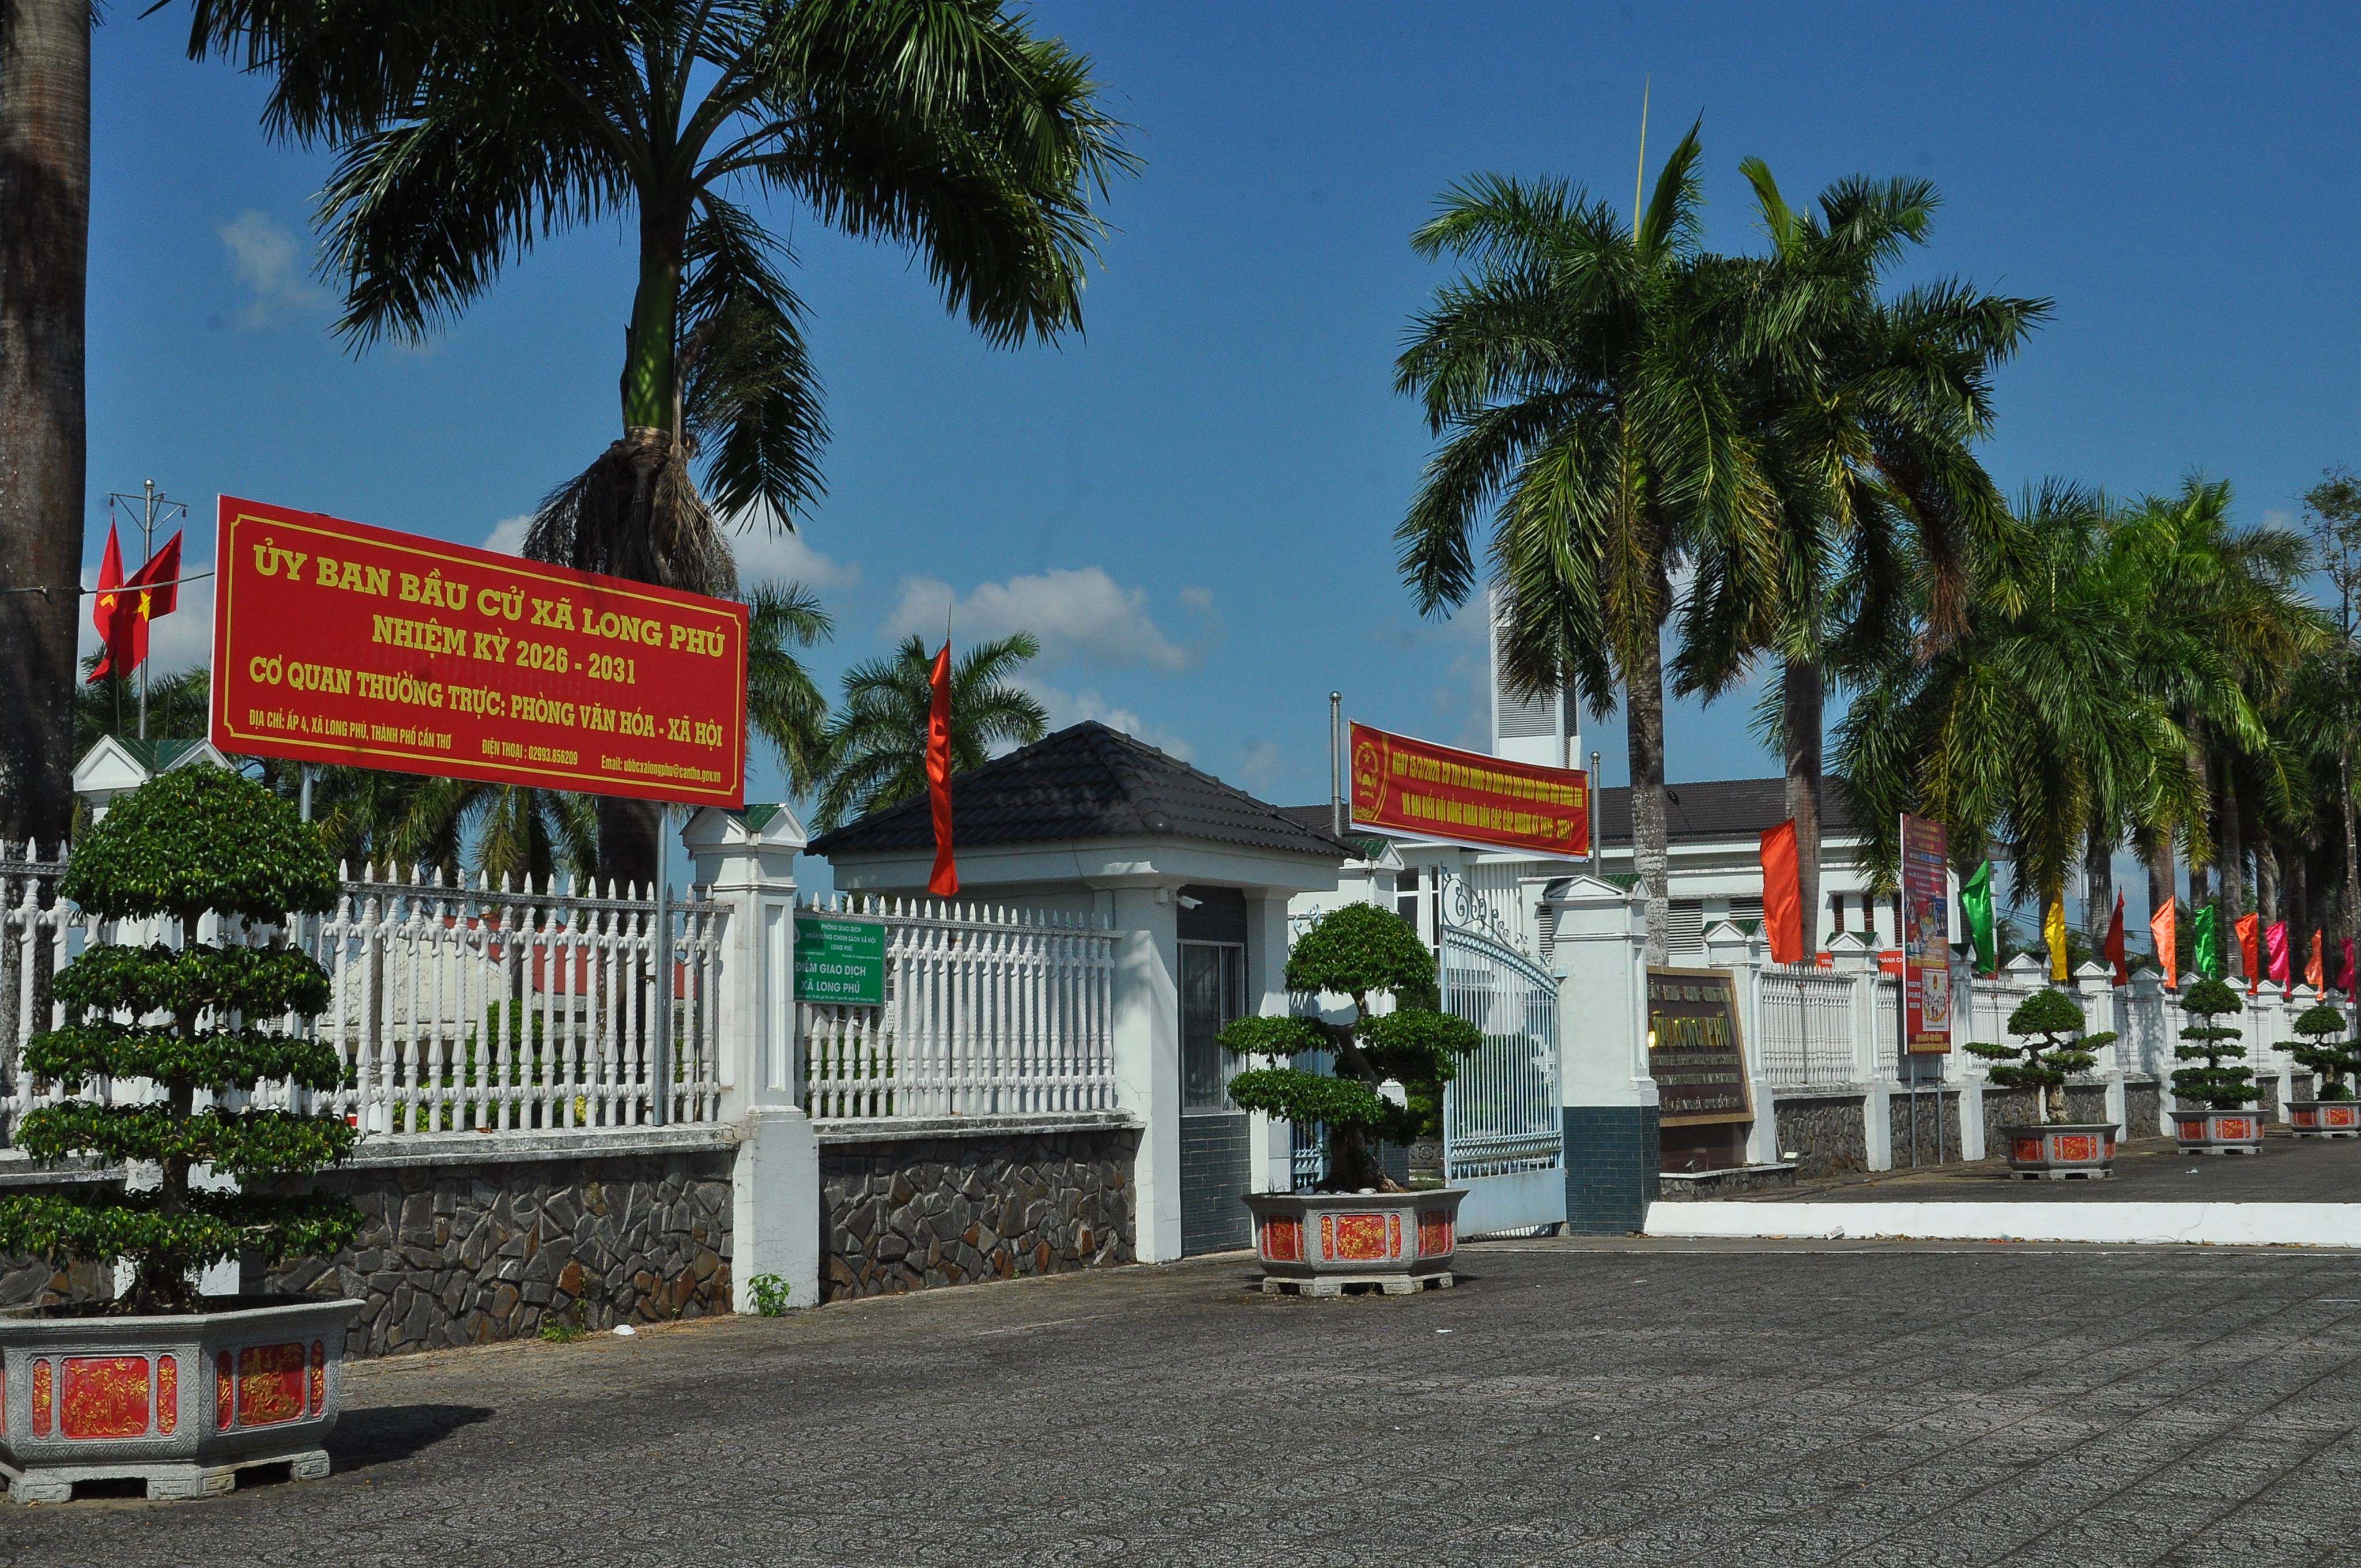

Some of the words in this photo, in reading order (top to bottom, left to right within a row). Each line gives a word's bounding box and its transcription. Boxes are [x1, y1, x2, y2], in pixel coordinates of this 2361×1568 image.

[254, 537, 307, 581] ỦY
[316, 556, 391, 597] BAN
[399, 568, 469, 610] BẦU
[477, 585, 525, 620] CỬ
[531, 597, 575, 631] XÃ
[582, 608, 663, 646] LONG
[669, 624, 725, 657] PHÚ
[372, 615, 466, 658] NHIỆM
[473, 628, 510, 663] KỲ
[516, 640, 568, 673] 2026
[588, 653, 635, 684] 2031
[250, 655, 282, 685] CƠ
[288, 662, 352, 695] QUAN
[357, 671, 443, 707] THƯỜNG
[448, 685, 505, 719] TRỰC:
[511, 692, 575, 726] PHÒNG
[579, 702, 616, 732] VĂN
[619, 707, 655, 737] HÓA
[667, 715, 691, 742] XÃ
[695, 719, 723, 751] HỘI
[249, 709, 264, 729] ĐỊA
[267, 708, 285, 729] CHỈ:
[287, 708, 299, 730] ẤP
[301, 717, 309, 734] 4,
[312, 715, 323, 734] XÃ
[326, 719, 347, 736] LONG
[350, 720, 369, 741] PHÚ,
[371, 723, 398, 743] THÀNH
[400, 725, 417, 745] PHỐ
[437, 733, 452, 749] THƠ
[482, 737, 500, 758] ĐIỆN
[502, 741, 523, 761] THOẠI
[528, 747, 578, 766] 02993.856209
[601, 754, 623, 771] Email:
[795, 957, 817, 973] ĐIỂM
[820, 964, 842, 975] GIAO
[844, 965, 866, 978] DỊCH
[801, 978, 814, 990] XÃ
[816, 981, 840, 992] LONG
[843, 981, 861, 993] PHÚ
[1671, 1017, 1704, 1047] LONG
[1705, 1011, 1730, 1047] PHÚ
